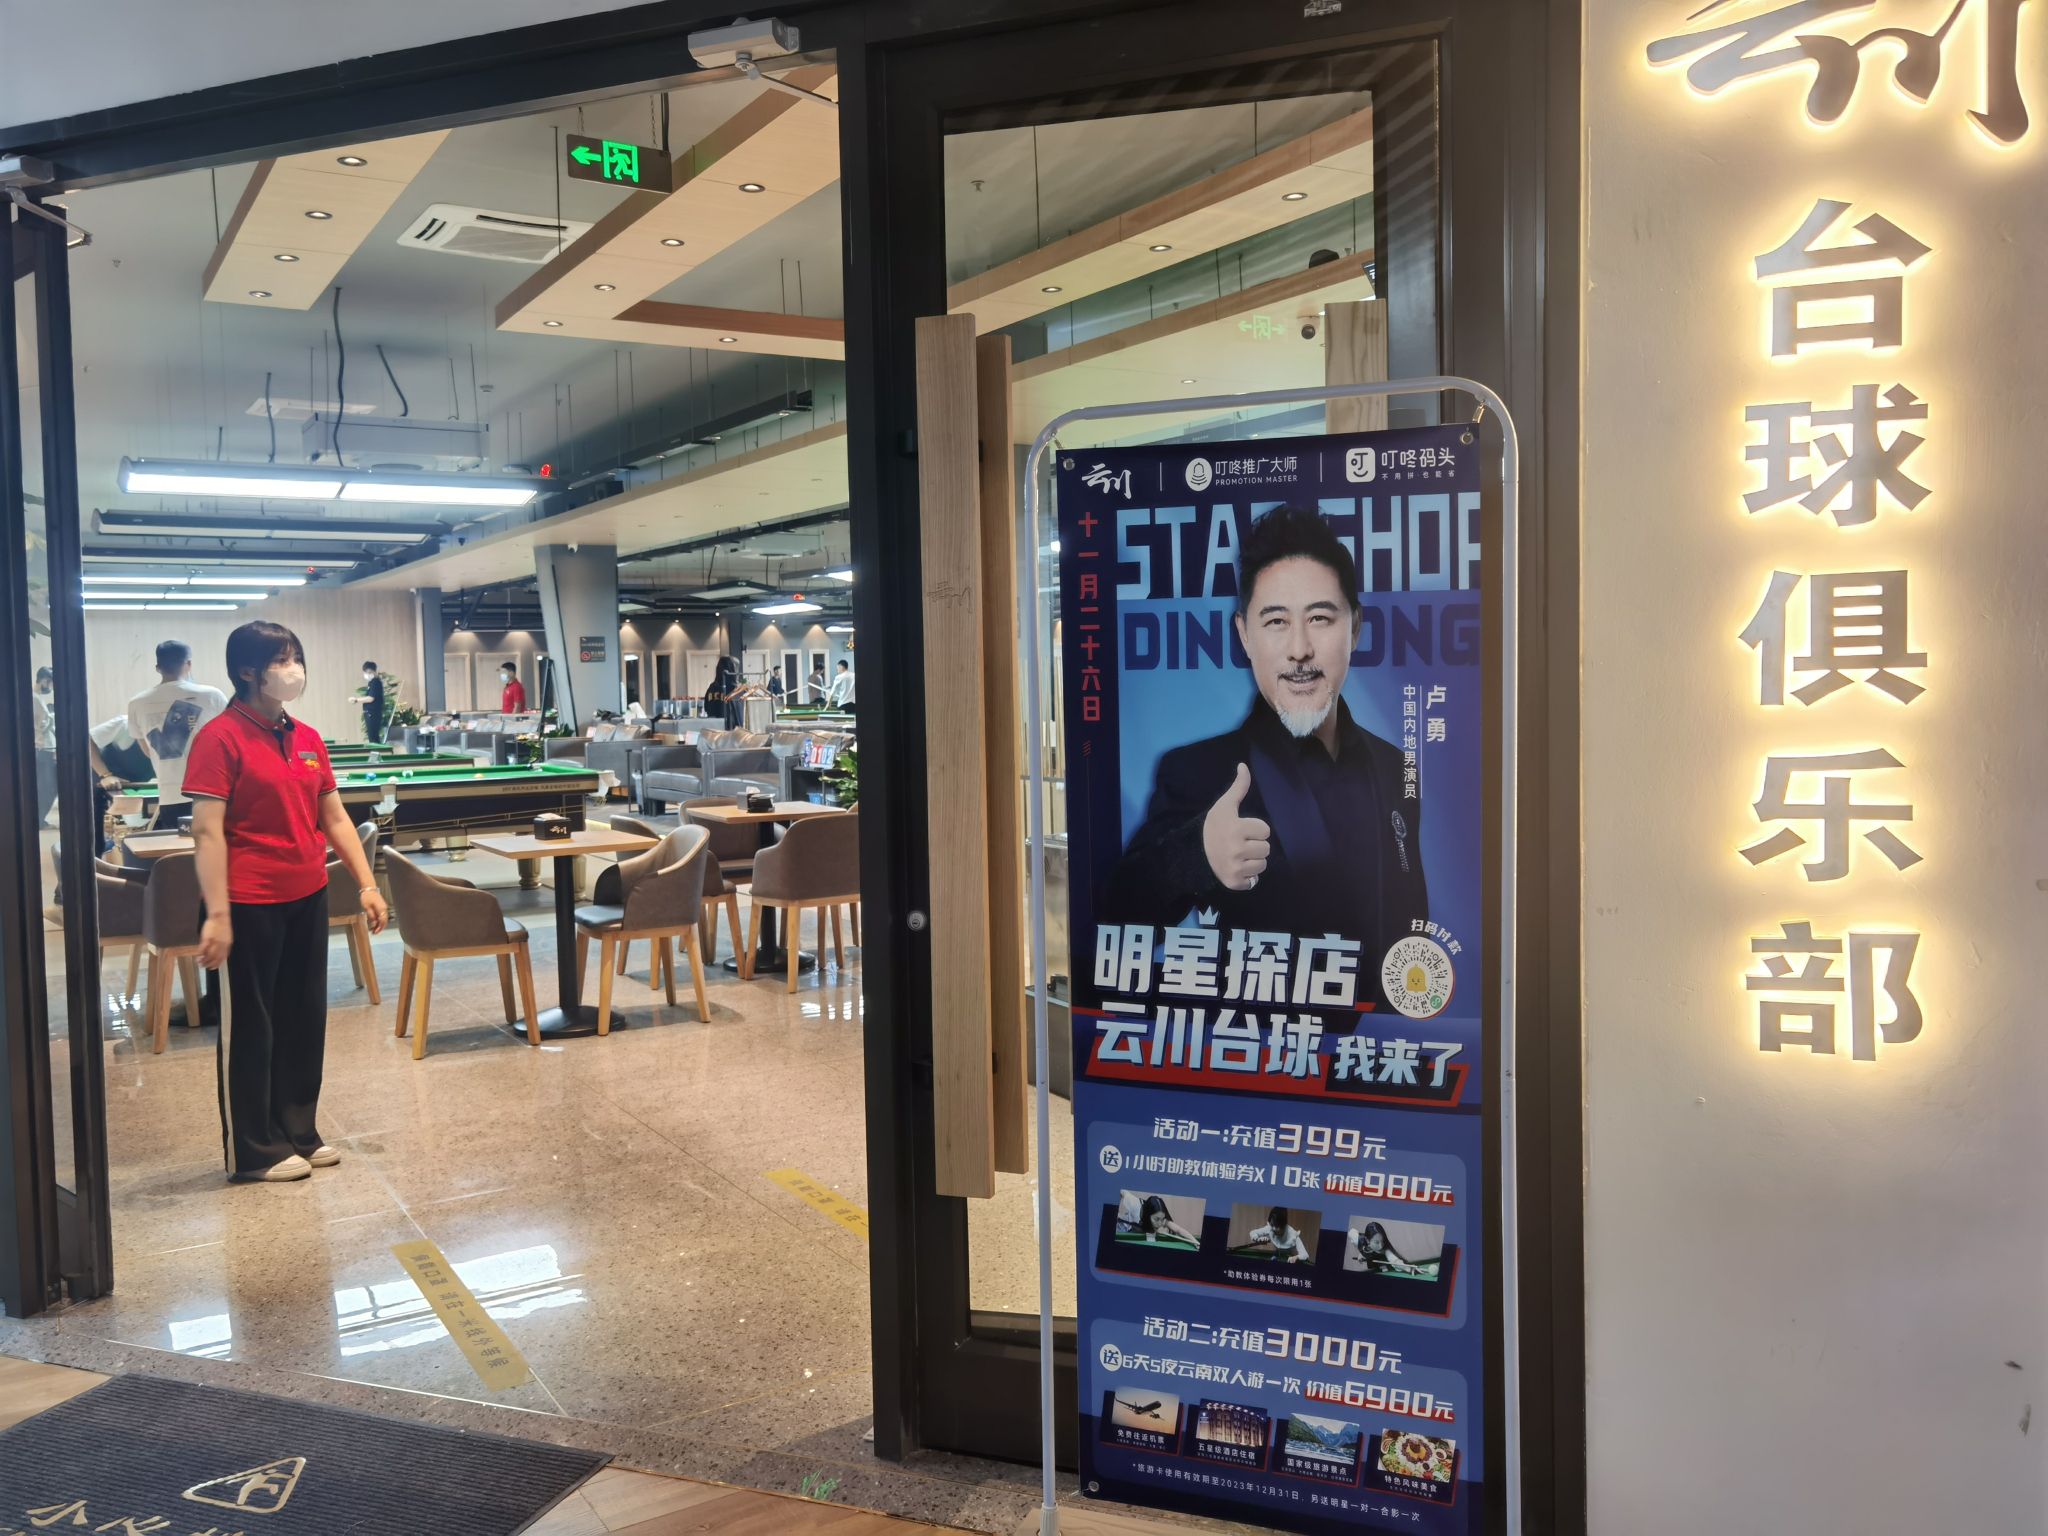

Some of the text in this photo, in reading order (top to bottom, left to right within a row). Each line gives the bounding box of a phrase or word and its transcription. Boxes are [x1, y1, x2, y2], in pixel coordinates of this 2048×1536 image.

[1215, 456, 1298, 476] 叮咚推广大师
[1381, 447, 1455, 469] 叮咚码头
[1215, 474, 1298, 486] PROMOTION MASTER
[1077, 512, 1102, 721] 十一月二十六日
[1738, 198, 1934, 1061] 台球俱乐部
[1426, 685, 1447, 742] 卢勇
[1403, 684, 1417, 799] 中国内地男演员
[1411, 919, 1462, 955] 扫码付款
[1094, 923, 1362, 1007] 明星探店
[1096, 1001, 1463, 1087] 云川台球 我来了
[1325, 1171, 1453, 1203] 价值980元
[1306, 1380, 1454, 1420] 价值6980元
[1117, 1429, 1165, 1444] 免费往返机票
[1198, 1443, 1256, 1460] 五星级酒店住宿
[1287, 1458, 1347, 1476] 国家级旅游景点
[1384, 1475, 1437, 1493] 特色风味美食
